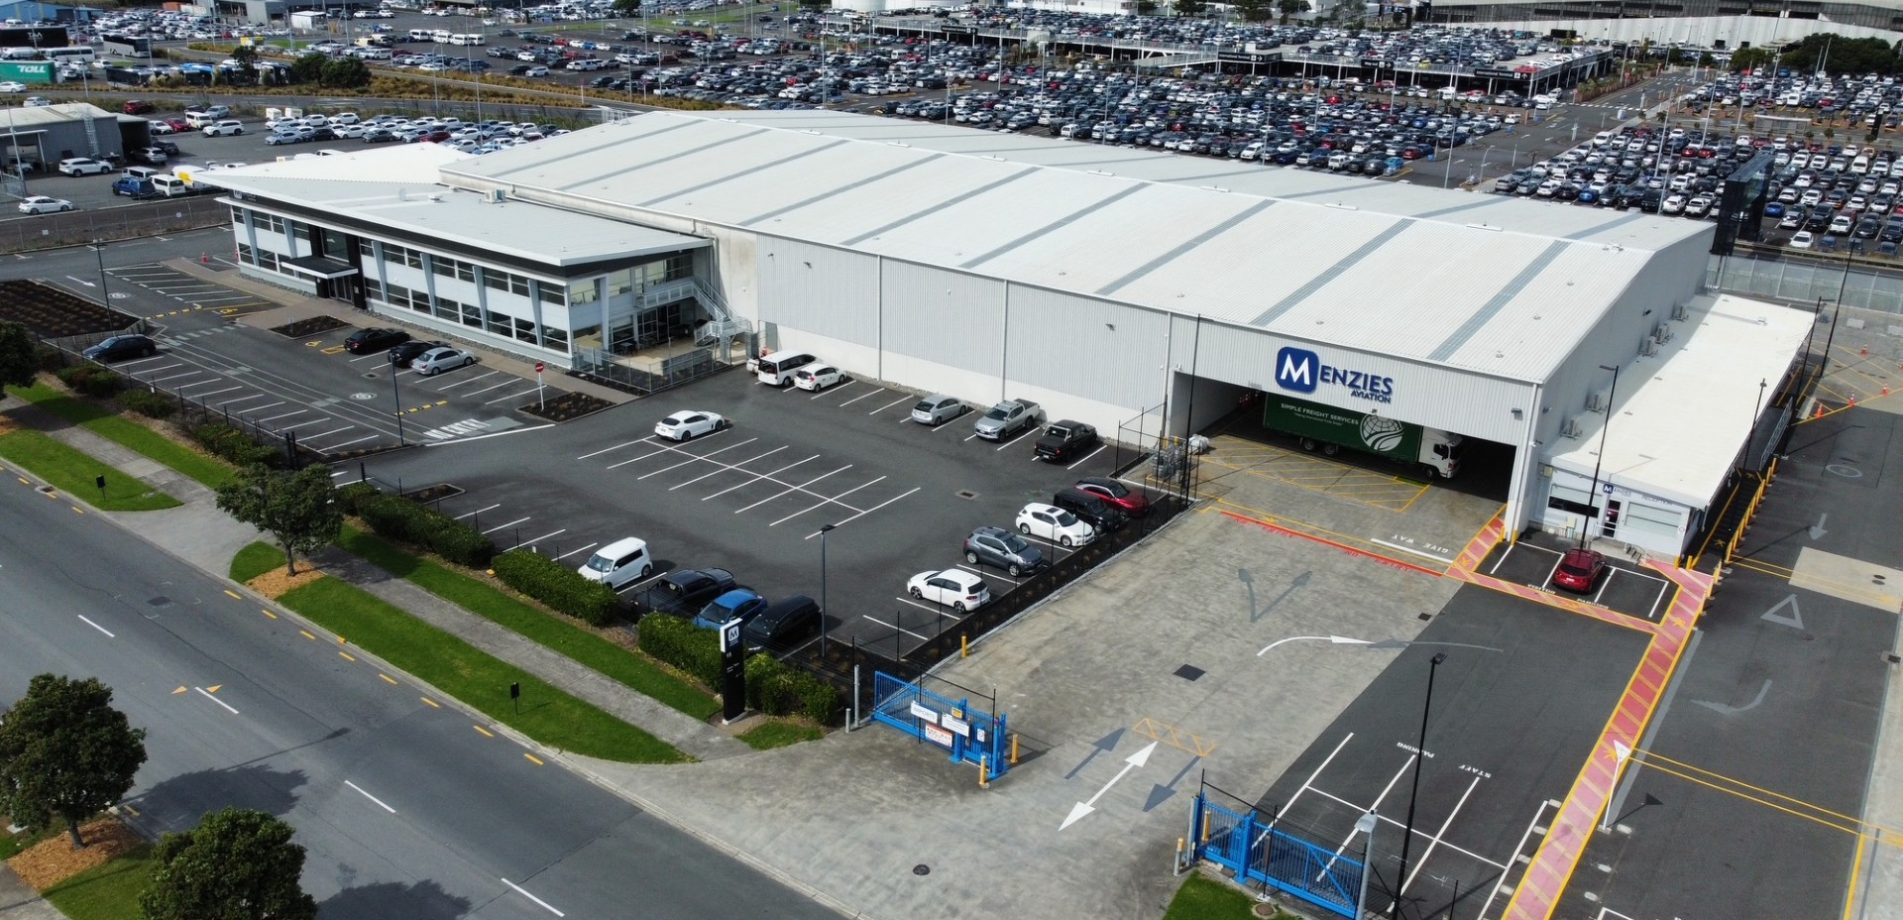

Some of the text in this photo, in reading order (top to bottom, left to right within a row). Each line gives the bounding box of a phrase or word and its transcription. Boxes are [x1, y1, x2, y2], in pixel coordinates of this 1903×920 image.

[17, 65, 46, 73] TOLL
[1279, 352, 1393, 396] MENZIES
[1350, 389, 1392, 404] AVIATION
[1302, 408, 1329, 419] FREIGHT
[1330, 414, 1359, 425] SERVICES
[1391, 534, 1449, 554] GIVE WAY
[1396, 741, 1435, 758] PAKING
[1459, 764, 1491, 778] STAFF
